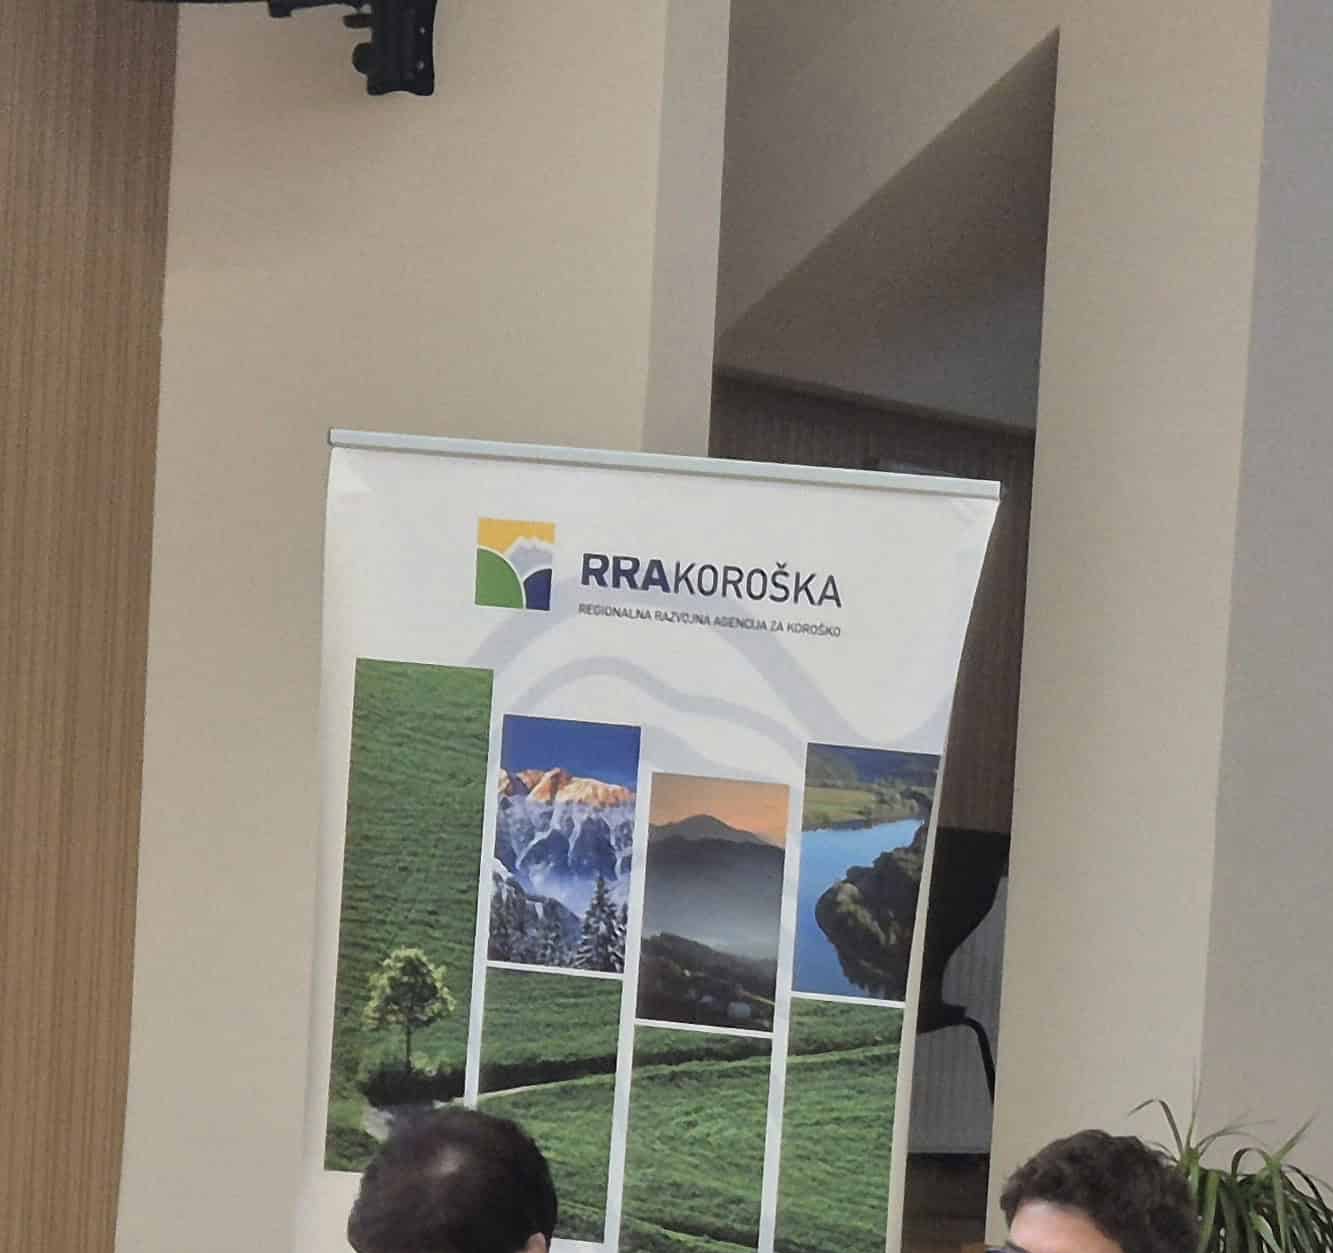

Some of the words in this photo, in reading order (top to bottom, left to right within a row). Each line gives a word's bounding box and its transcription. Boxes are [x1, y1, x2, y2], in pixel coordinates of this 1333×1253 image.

[578, 603, 651, 620] REGIONALNA
[654, 611, 711, 626] RAZVOJNA
[712, 616, 767, 631] AGENCIJA
[769, 620, 784, 632] ZA
[787, 621, 841, 637] KOROŠKO
